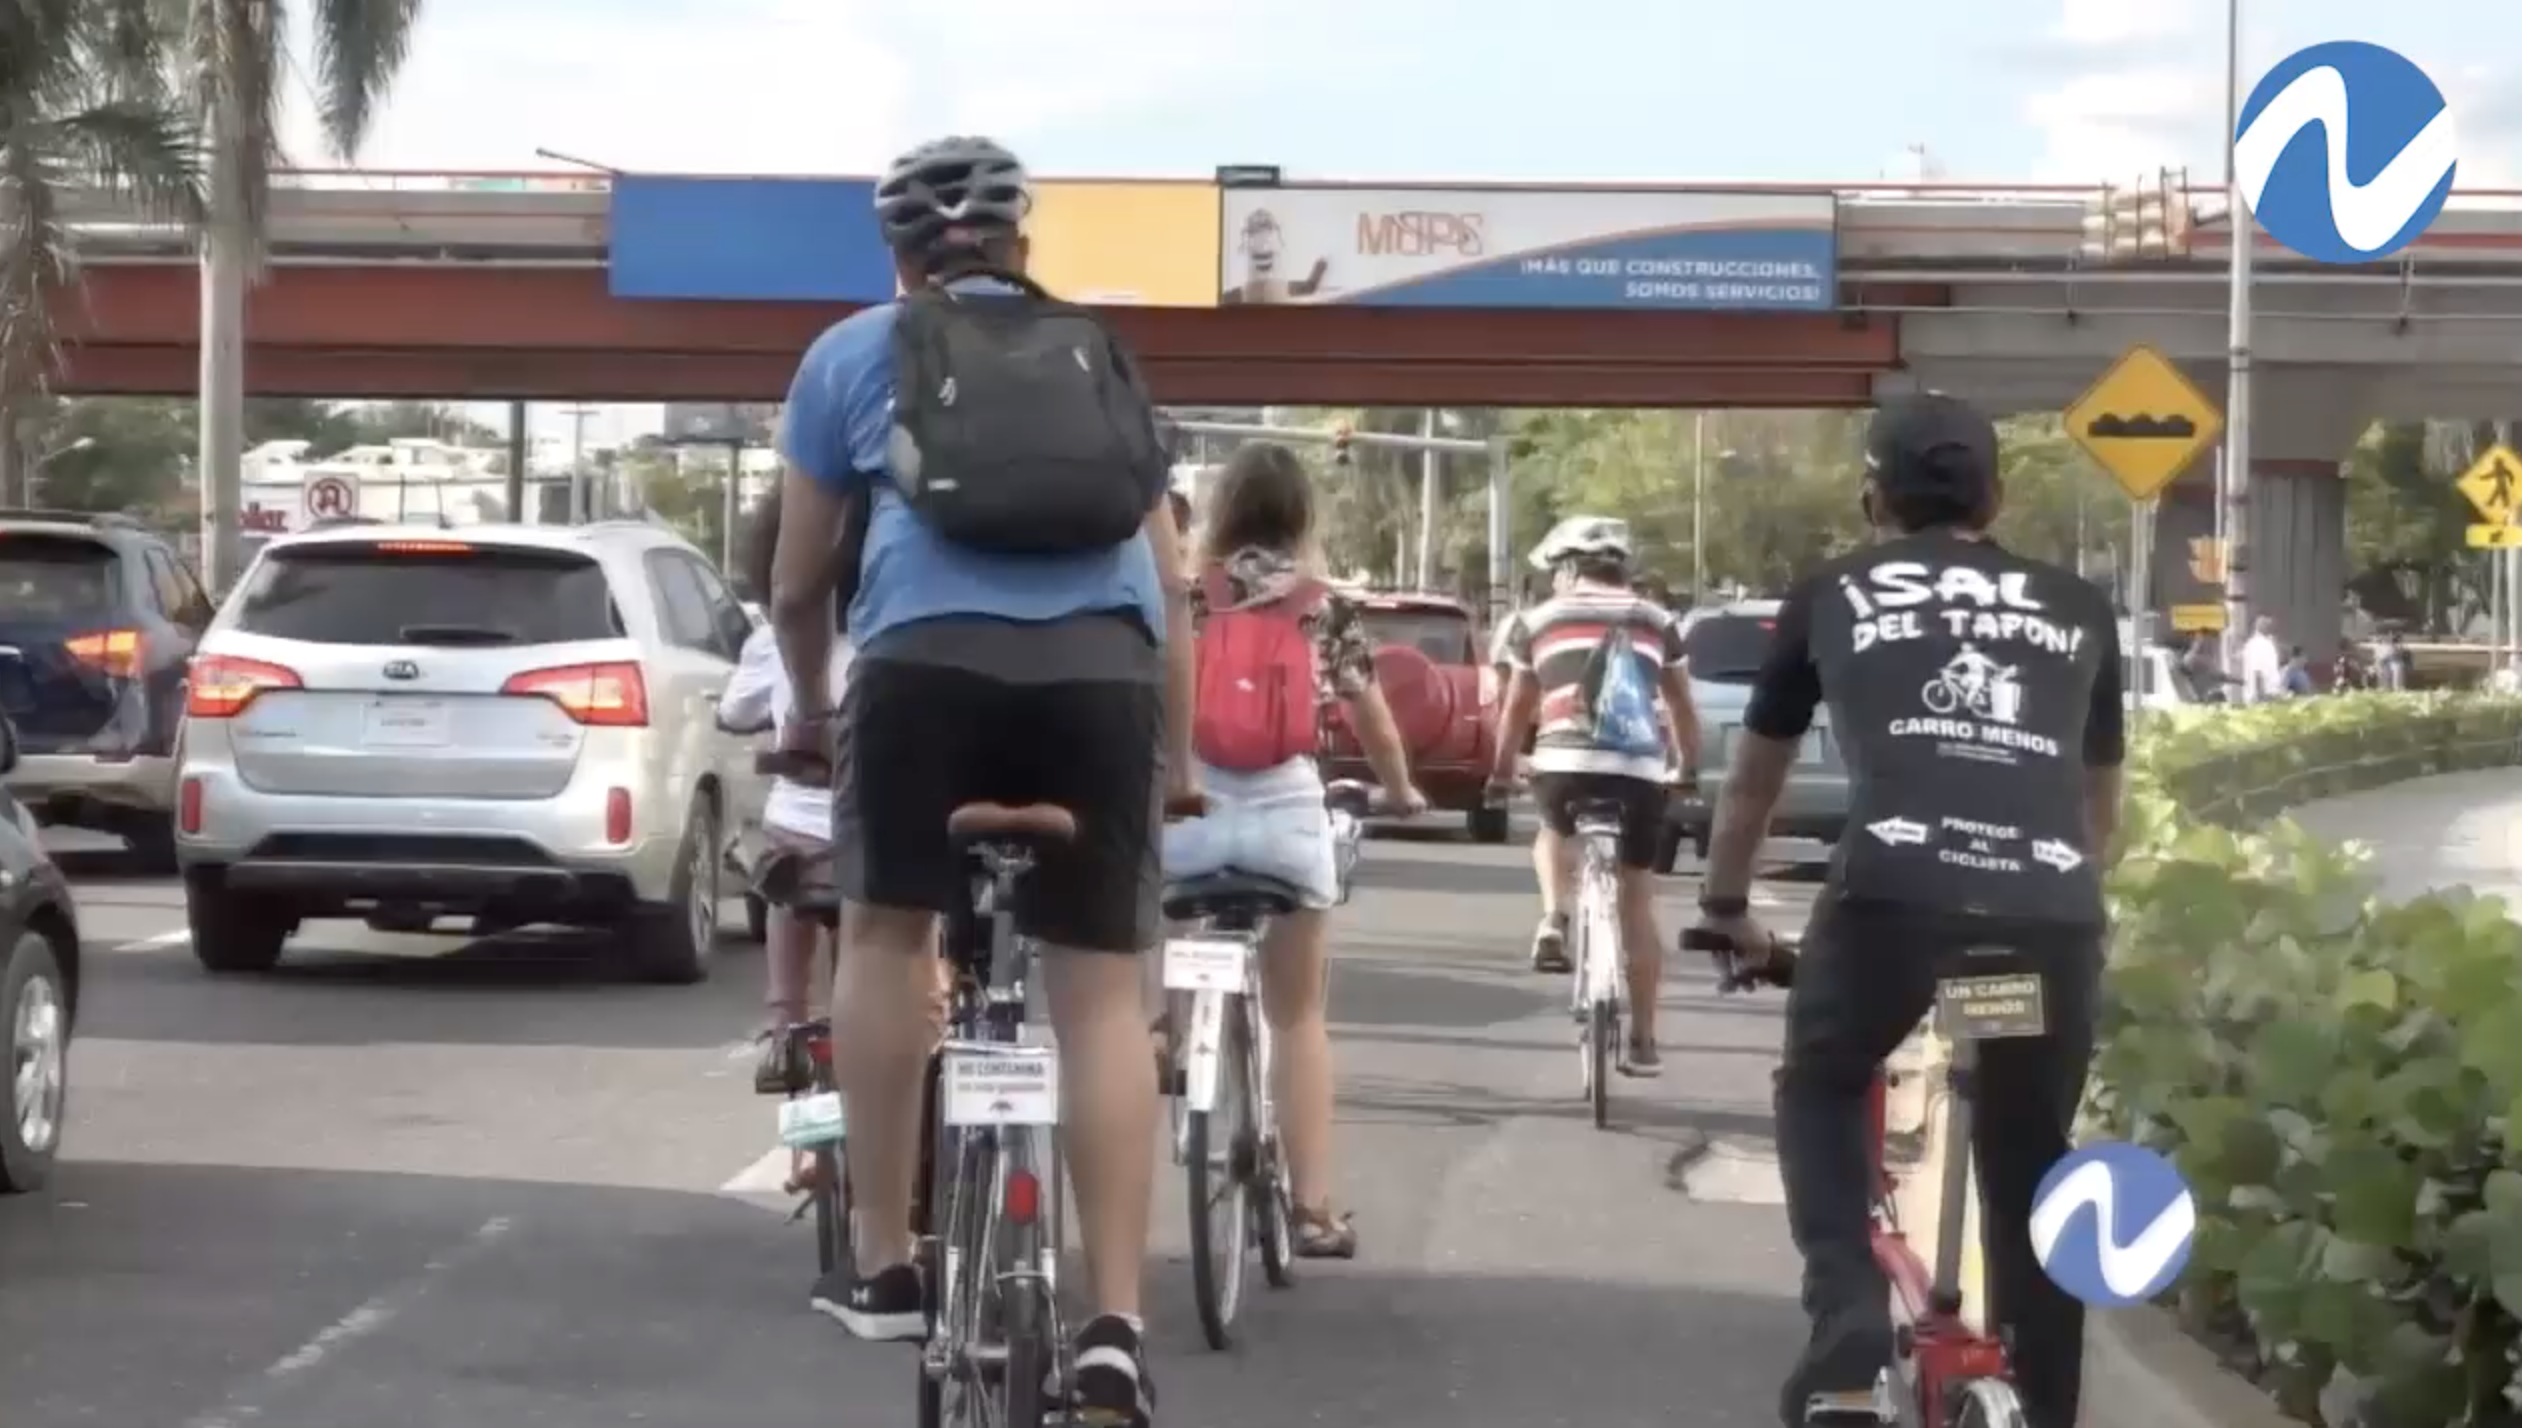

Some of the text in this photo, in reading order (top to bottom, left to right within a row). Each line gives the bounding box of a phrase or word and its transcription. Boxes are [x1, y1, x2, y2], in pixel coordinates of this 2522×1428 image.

[1576, 258, 1619, 275] QUE
[1625, 281, 1820, 301] SOMOS SERVICIOS!
[1839, 561, 2044, 619] ¡SAL
[1852, 610, 1924, 652] DEL
[1888, 717, 1974, 738] CARRO
[1981, 724, 2059, 756] MENOS
[1941, 816, 2020, 840] PROTEGE
[1968, 838, 1991, 853] AL
[1938, 848, 2021, 872] CICLISTA
